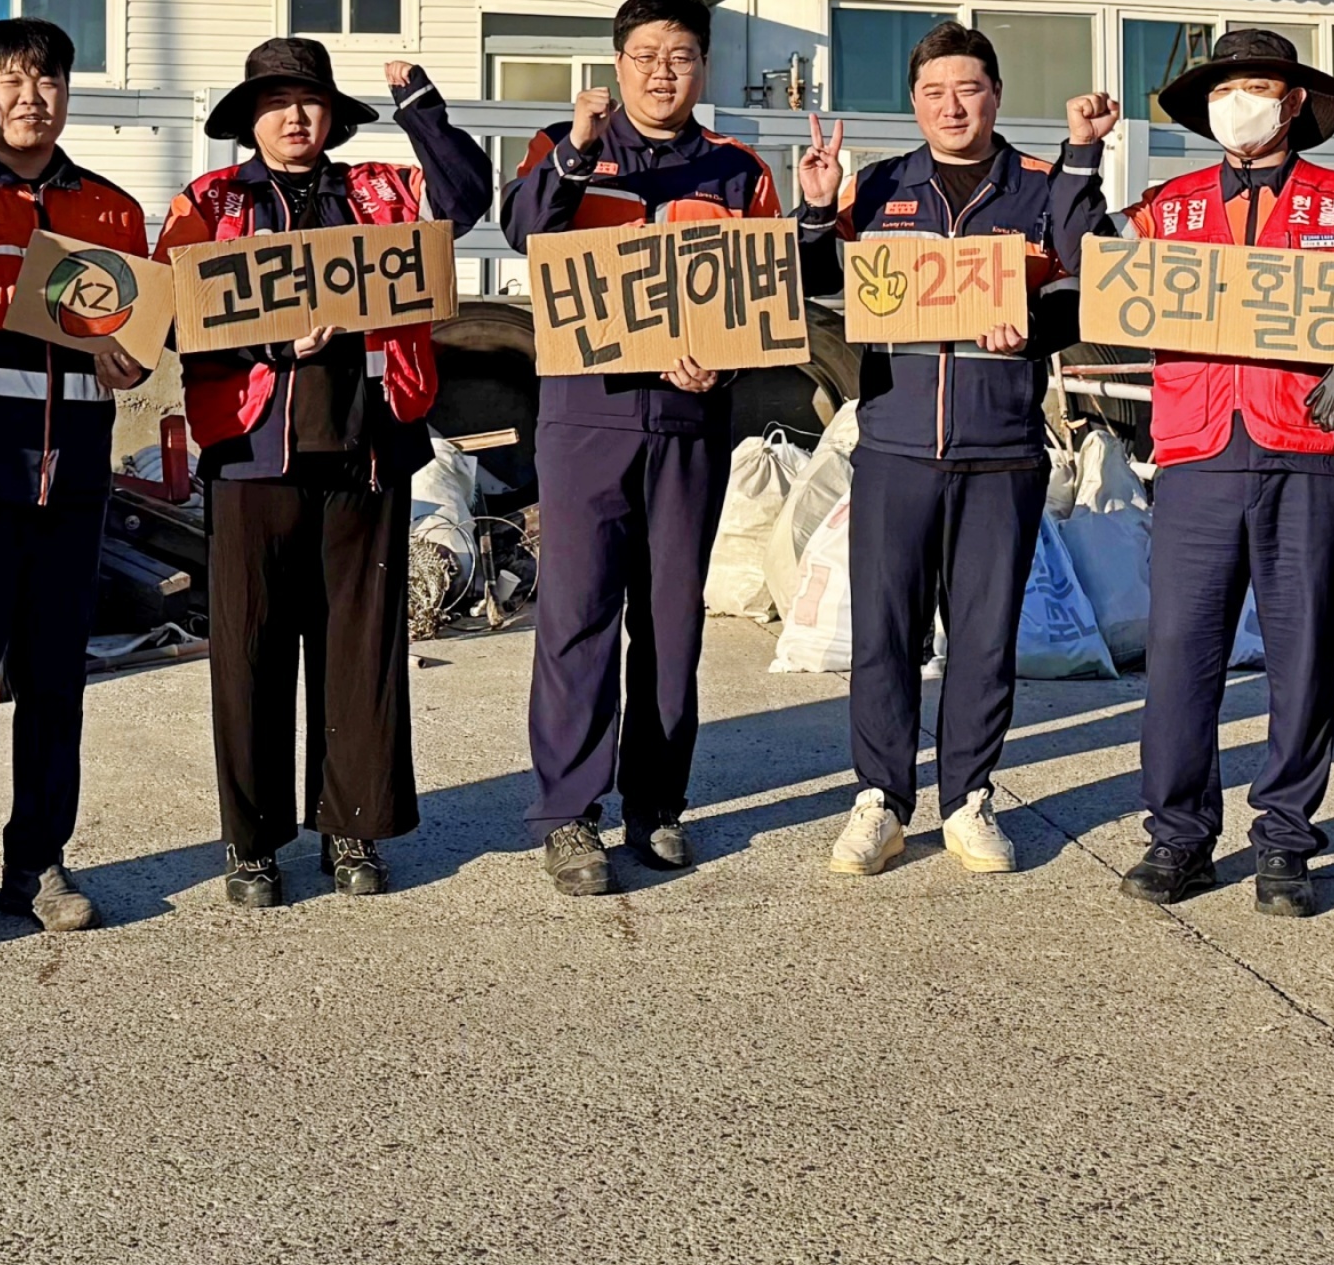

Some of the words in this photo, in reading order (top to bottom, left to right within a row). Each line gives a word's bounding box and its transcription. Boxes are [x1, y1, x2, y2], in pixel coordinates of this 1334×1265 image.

[68, 277, 114, 313] KZ
[197, 229, 434, 329] 고려아연
[540, 224, 806, 368] 반려해변
[912, 241, 1017, 308] 2차
